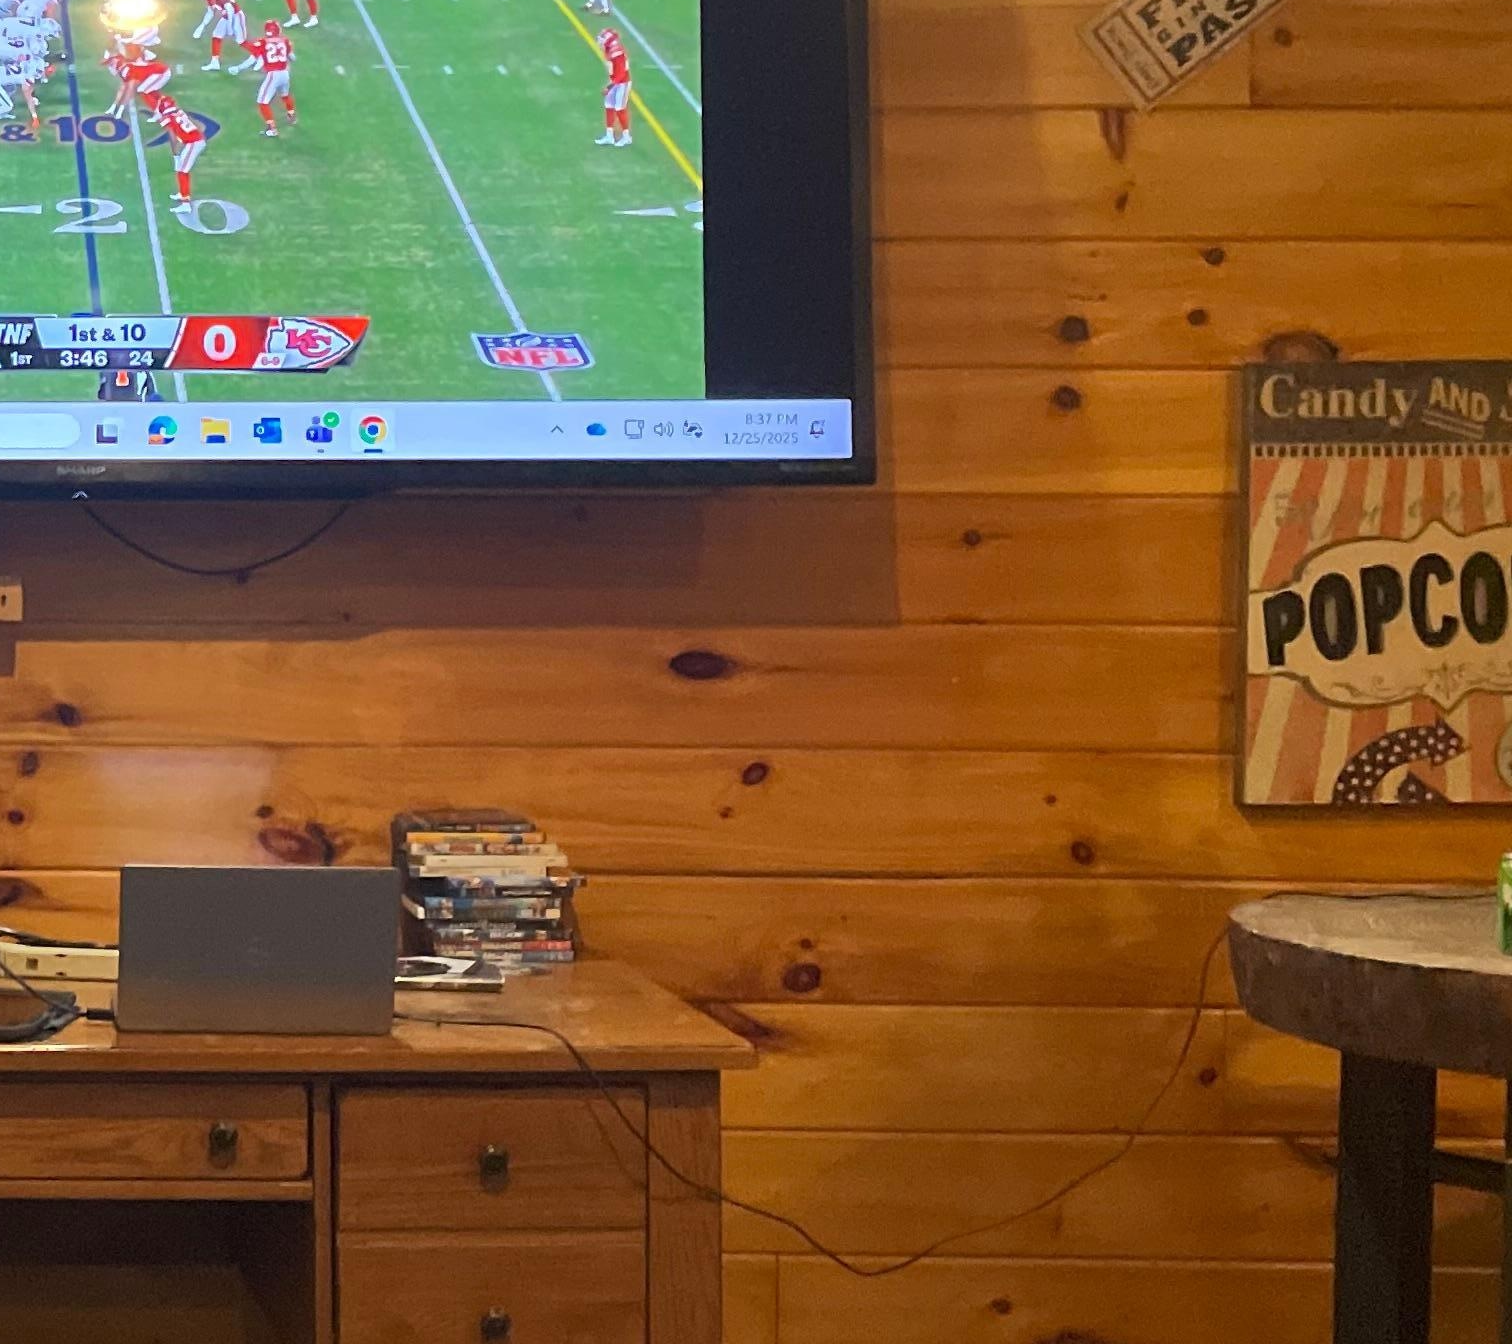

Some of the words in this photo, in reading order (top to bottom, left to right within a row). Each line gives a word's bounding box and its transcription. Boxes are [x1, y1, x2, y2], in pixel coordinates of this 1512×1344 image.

[0, 123, 35, 144] &
[48, 114, 132, 144] 10
[53, 196, 251, 235] 20
[68, 323, 98, 342] 1st
[101, 328, 117, 342] &
[120, 323, 147, 342] 10
[203, 324, 237, 362] 0
[59, 350, 108, 367] 3:46
[128, 350, 154, 367] 24
[493, 346, 579, 367] NFL
[1259, 372, 1419, 428] Candy
[1428, 376, 1491, 423] AND
[776, 412, 799, 426] PM
[723, 431, 800, 446] 12/25/2025
[1262, 550, 1510, 667] POPCO
